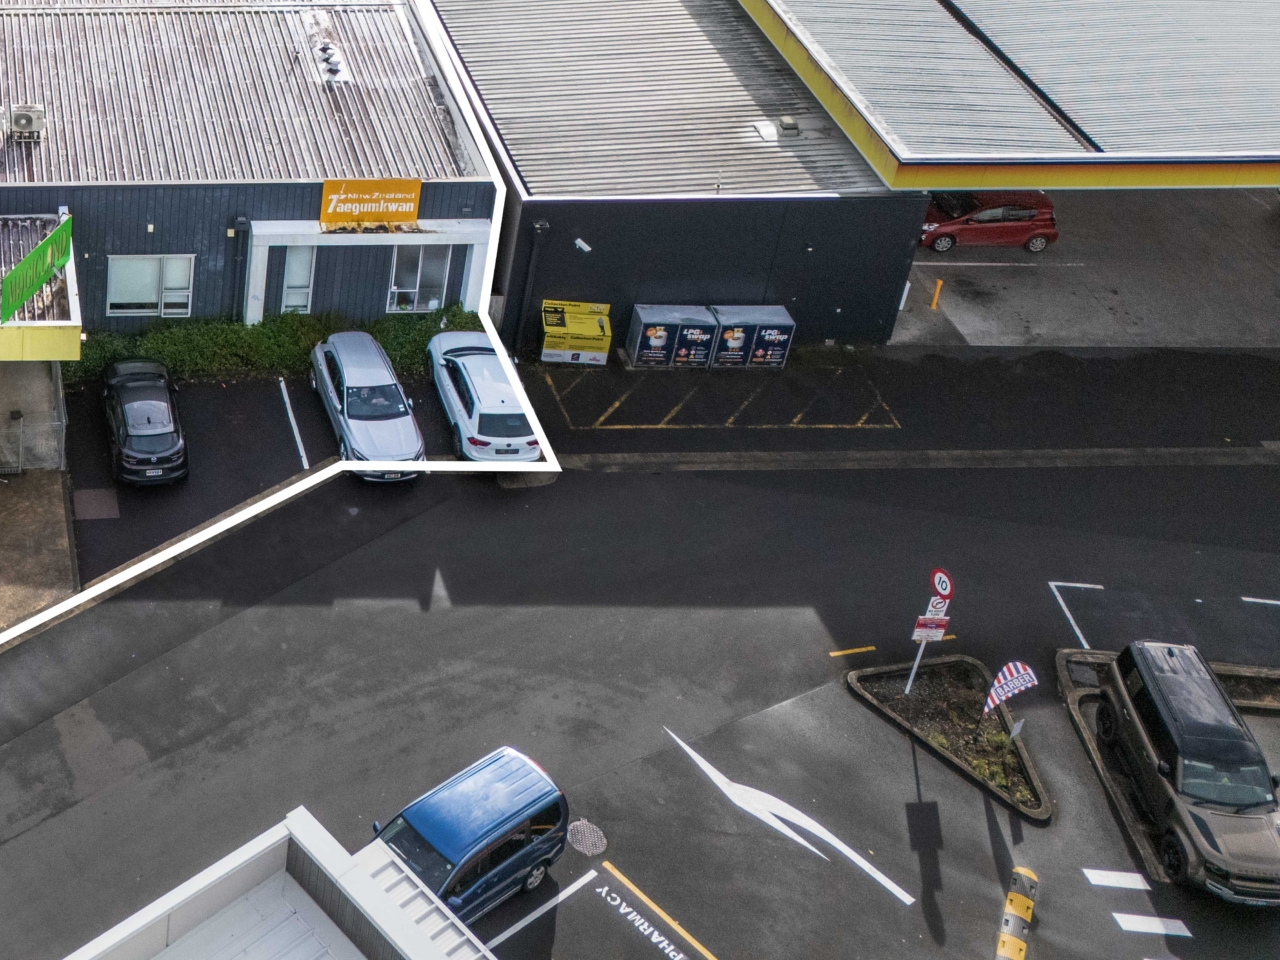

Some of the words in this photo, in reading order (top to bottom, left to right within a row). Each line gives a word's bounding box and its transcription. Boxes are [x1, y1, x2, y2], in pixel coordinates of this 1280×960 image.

[327, 193, 415, 215] Taegumkwan
[686, 333, 711, 341] swap
[937, 576, 948, 591] 10
[997, 672, 1033, 698] BARBER
[595, 885, 685, 960] PHARMACY
